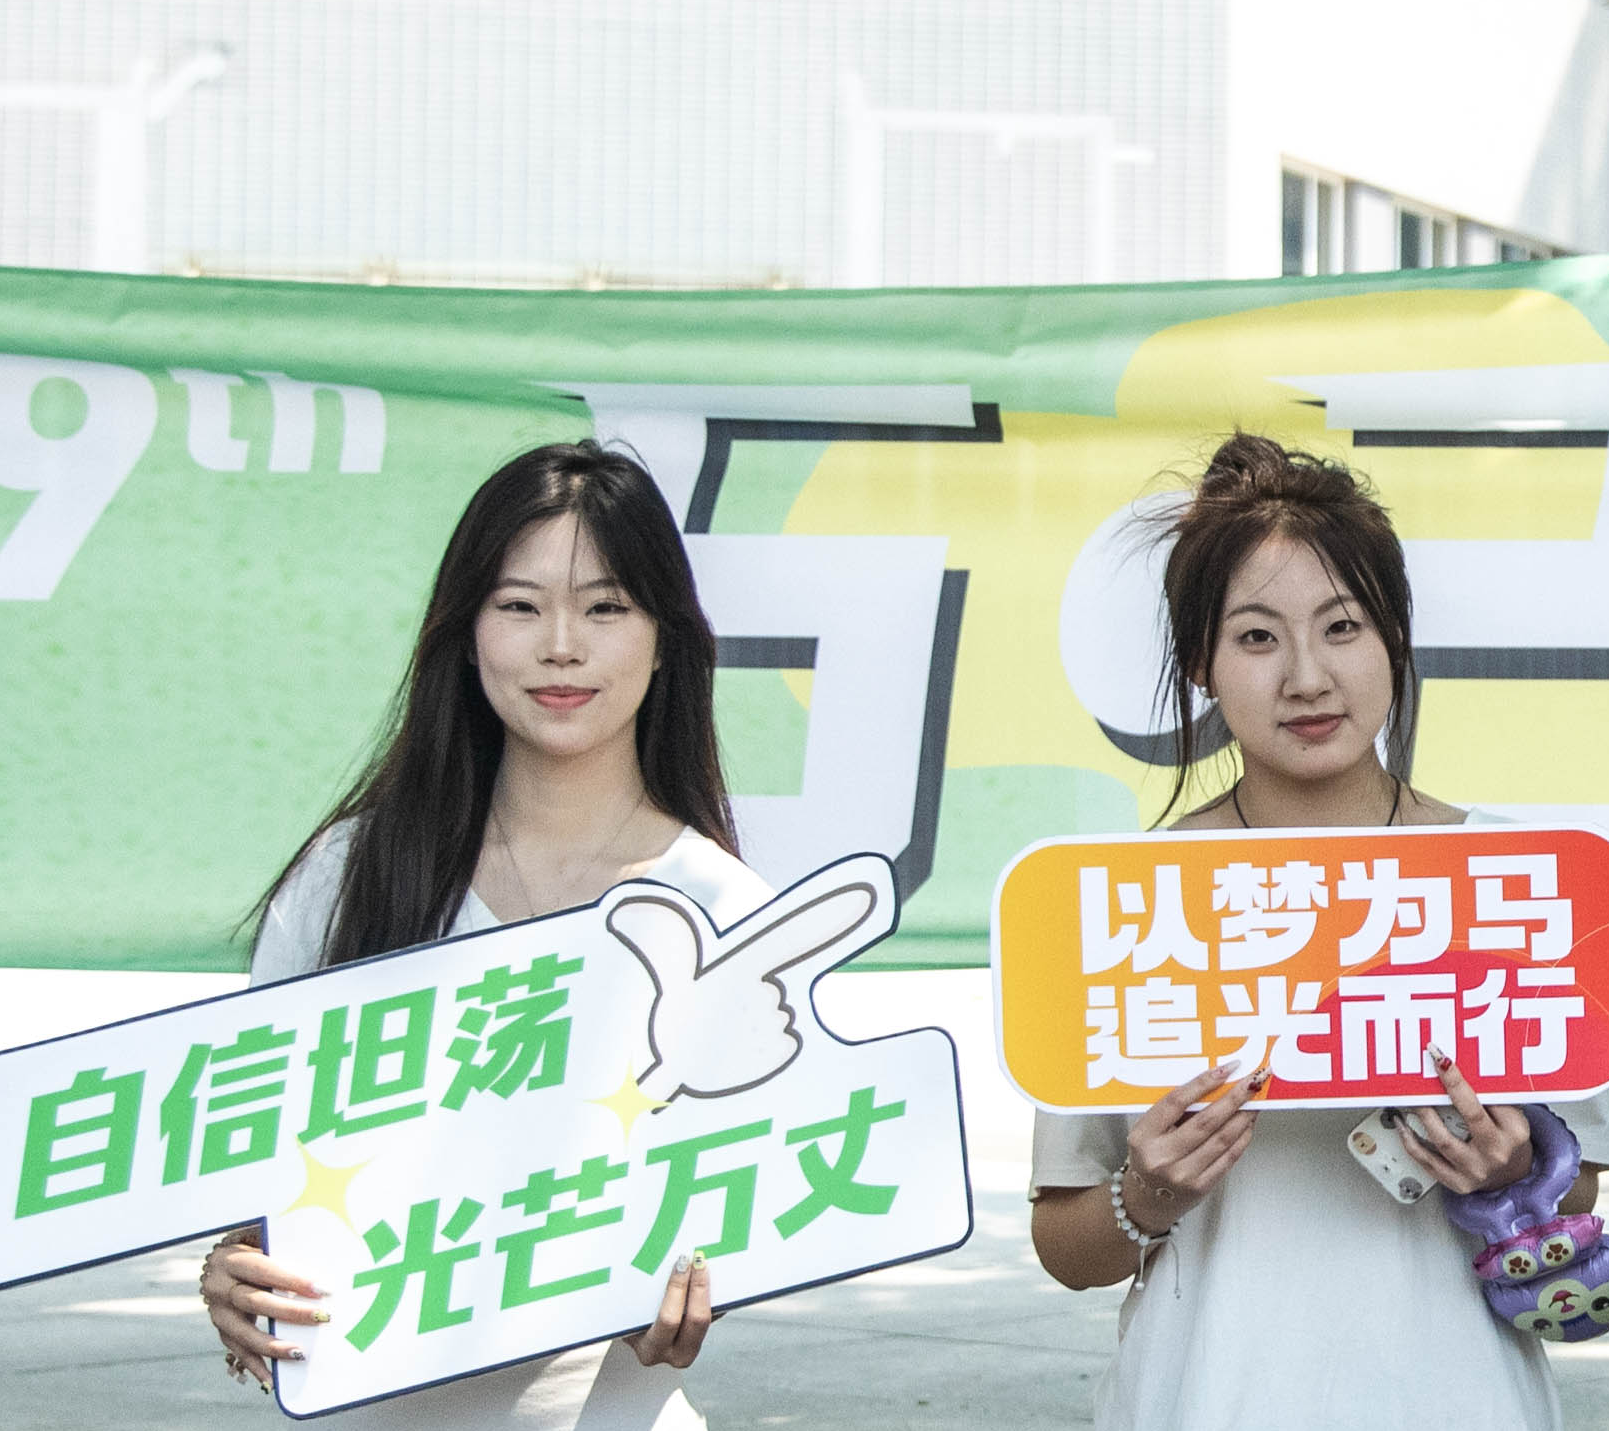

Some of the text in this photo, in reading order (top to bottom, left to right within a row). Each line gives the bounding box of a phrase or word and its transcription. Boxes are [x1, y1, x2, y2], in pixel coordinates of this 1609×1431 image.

[1079, 853, 1573, 973] 以梦为马
[15, 953, 586, 1220] 自信坦荡
[1085, 967, 1586, 1090] 追光而行
[344, 1086, 906, 1352] 光芒万丈
